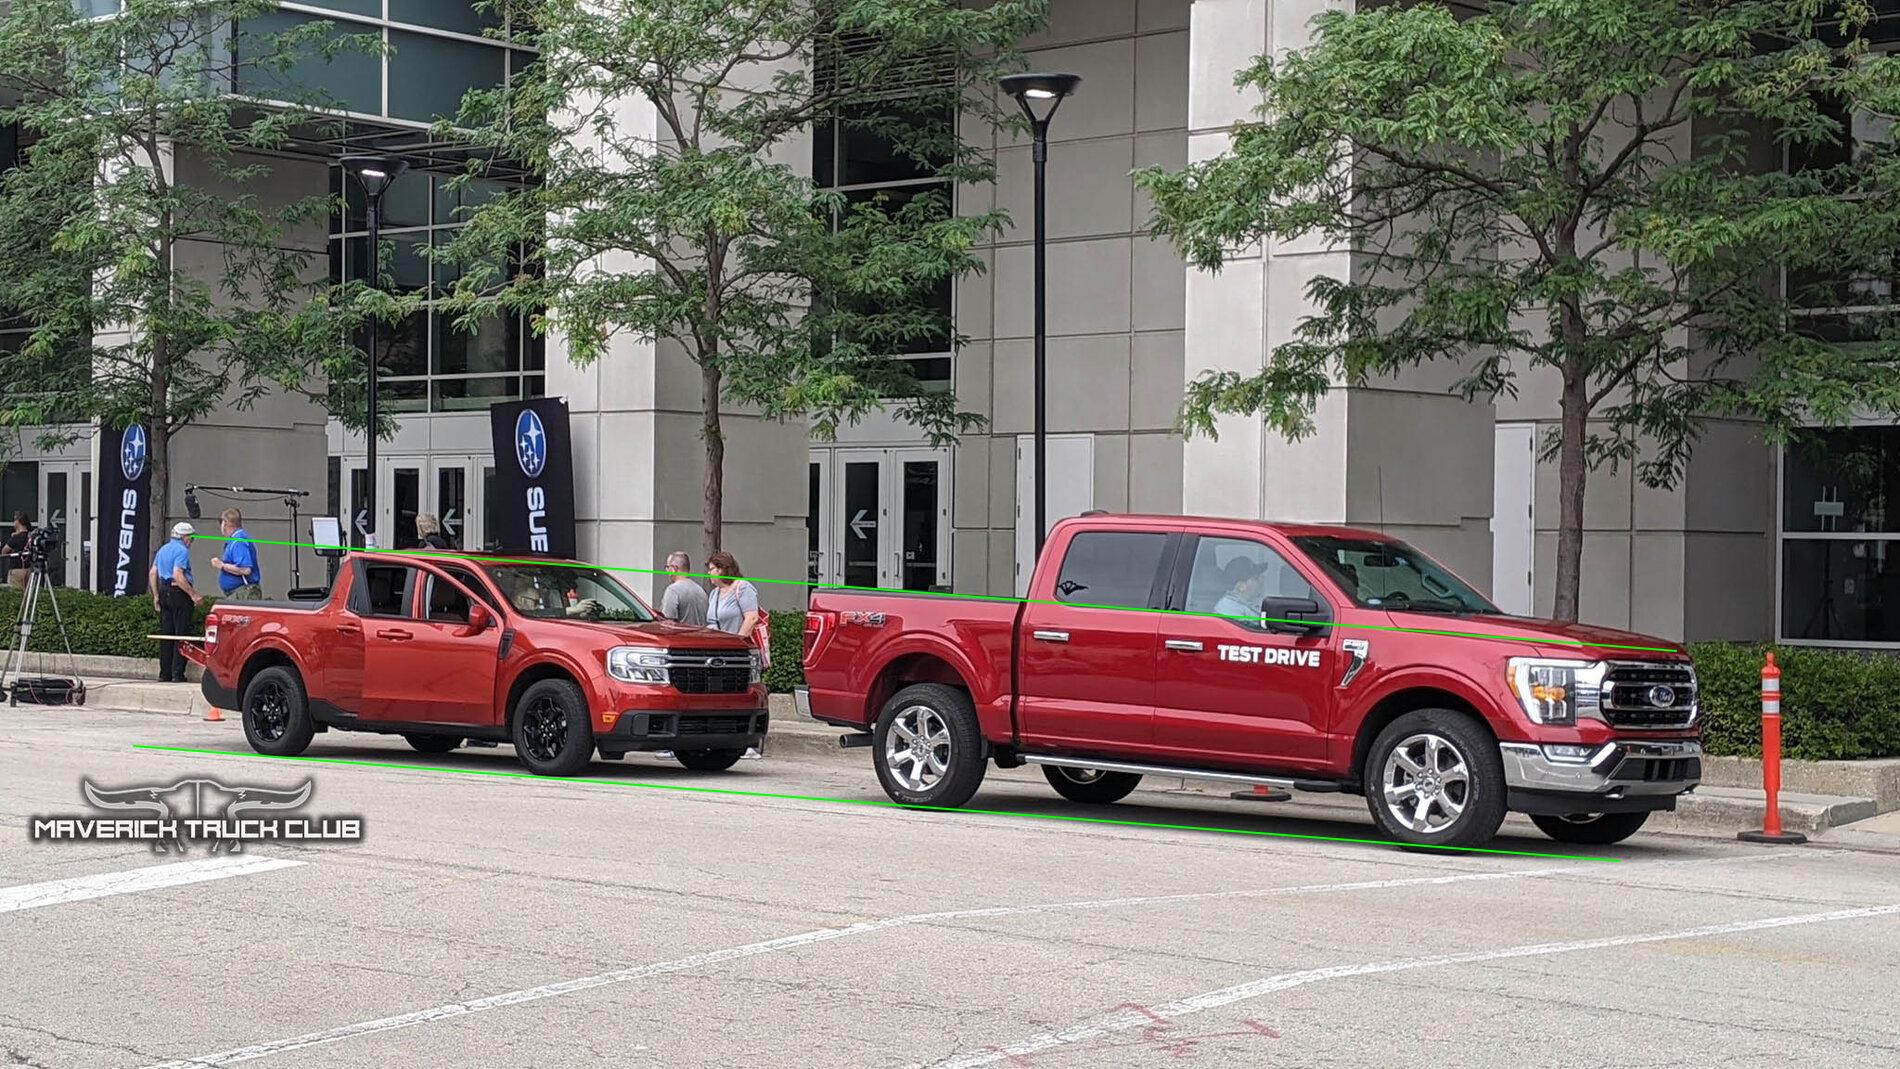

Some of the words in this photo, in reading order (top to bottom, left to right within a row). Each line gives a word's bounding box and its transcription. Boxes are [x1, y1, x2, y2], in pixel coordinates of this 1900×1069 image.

[840, 610, 886, 626] FX4
[1217, 644, 1263, 663] TEST
[1264, 648, 1321, 667] DRIVE
